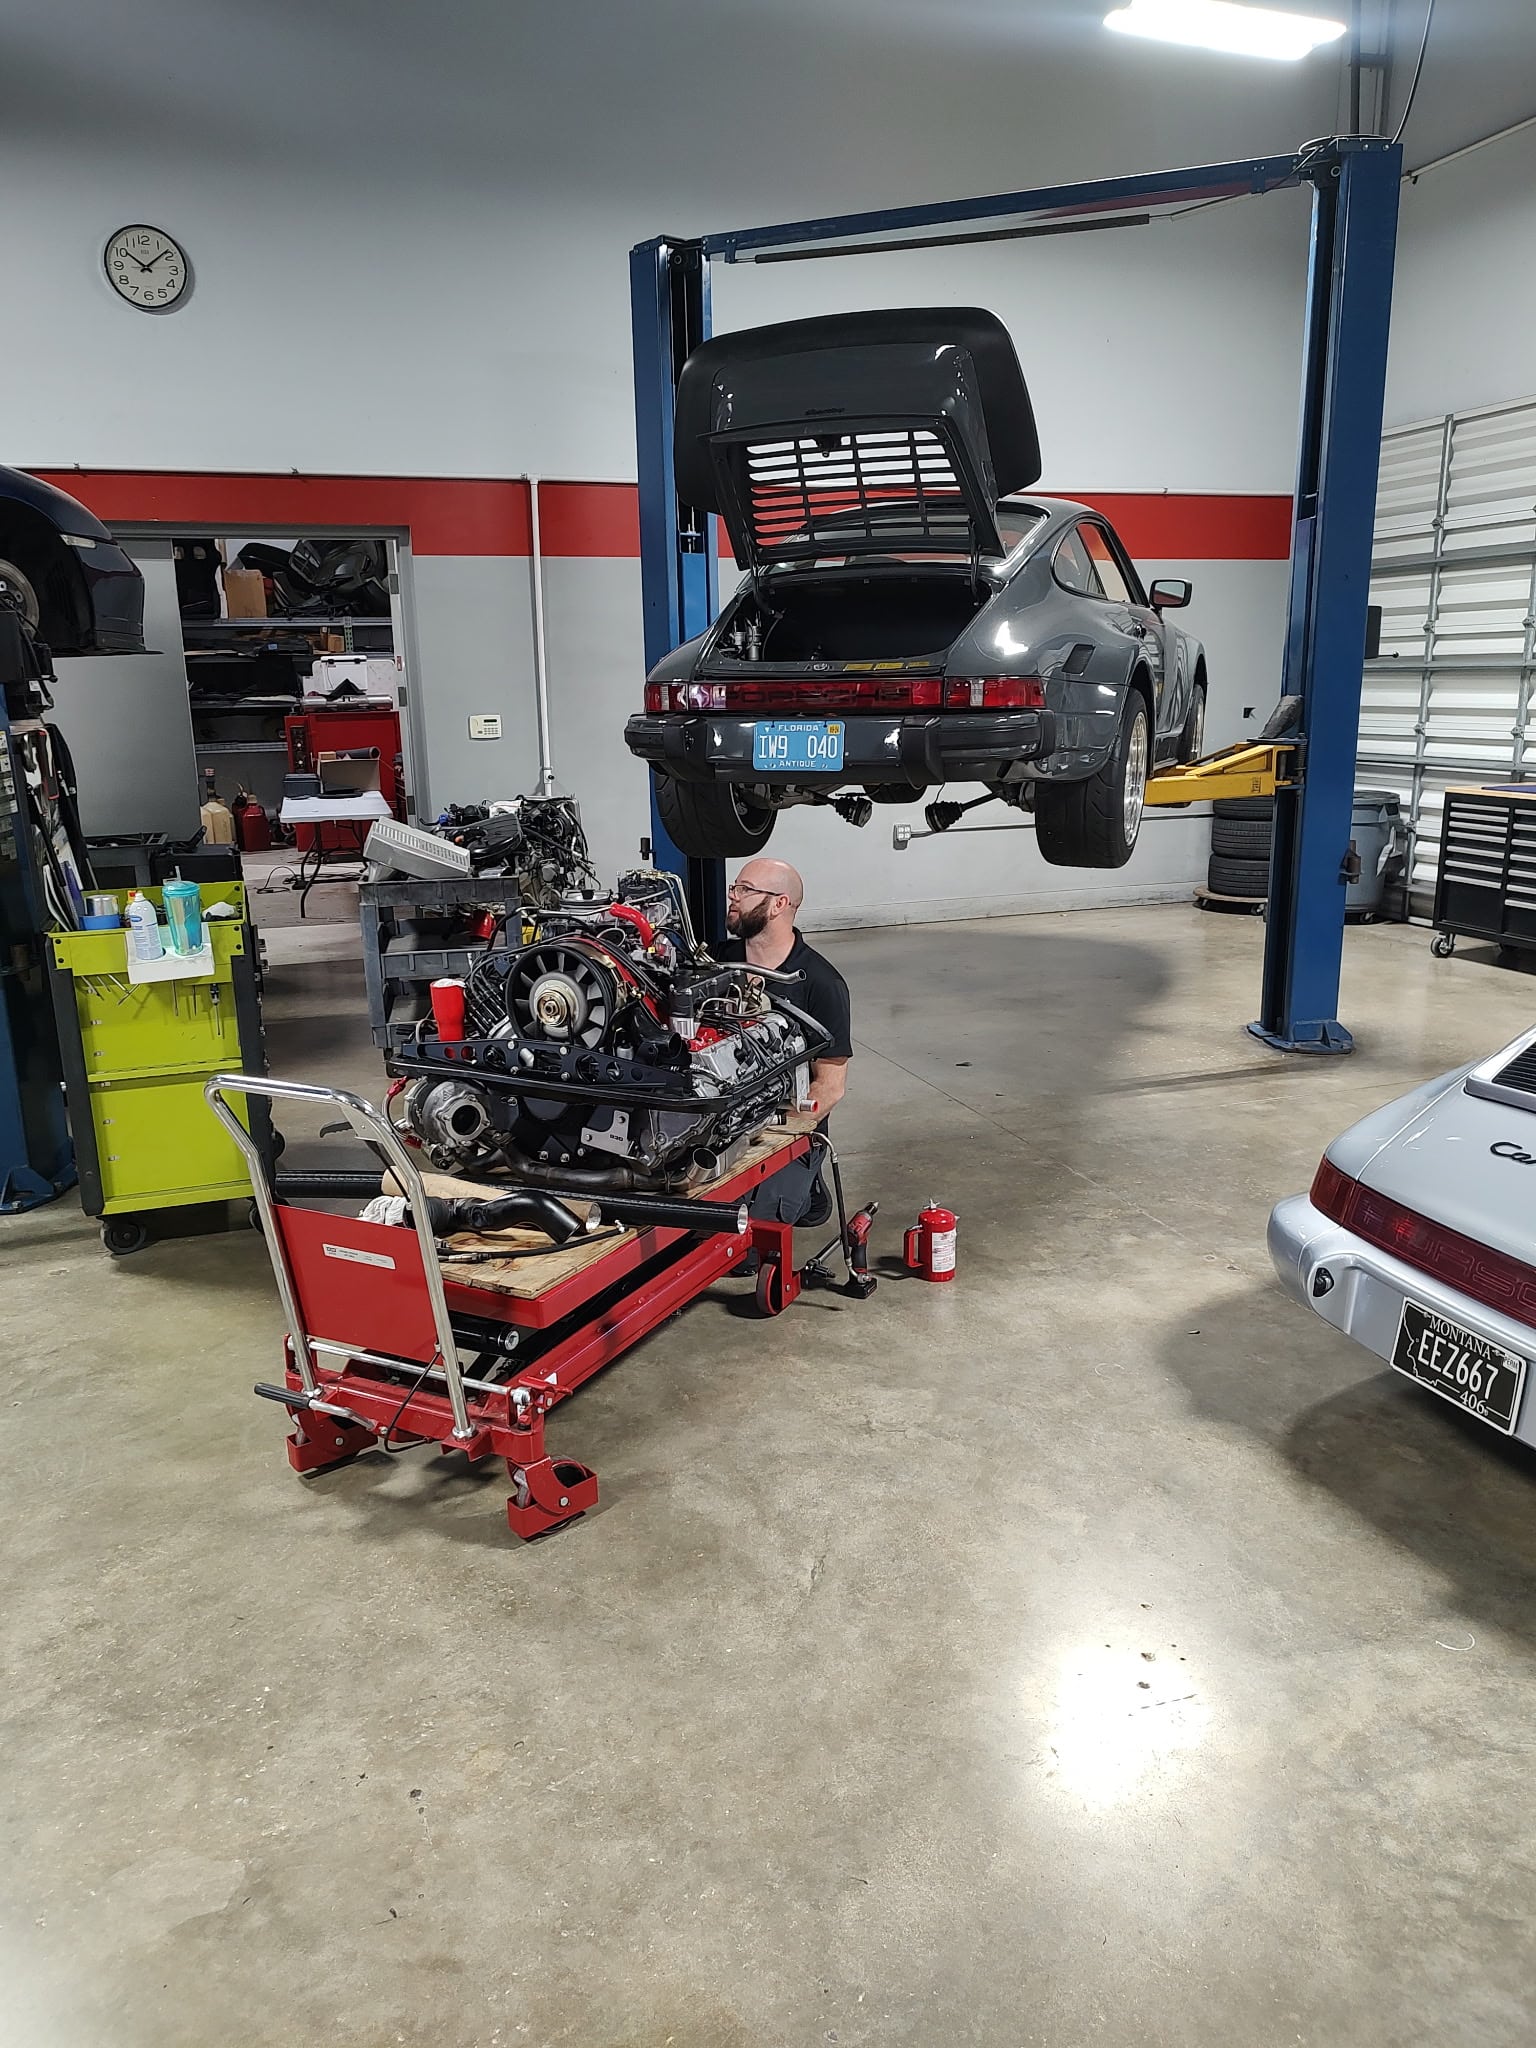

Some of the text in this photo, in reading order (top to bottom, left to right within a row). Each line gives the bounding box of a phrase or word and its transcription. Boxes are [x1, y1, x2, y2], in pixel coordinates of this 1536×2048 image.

[125, 236, 135, 248] 11
[137, 234, 150, 246] 12
[113, 246, 128, 258] 10
[164, 250, 175, 262] 2
[113, 260, 125, 271] 9
[168, 265, 179, 276] 3
[118, 274, 130, 285] 8
[165, 278, 176, 289] 4
[128, 285, 140, 296] 7
[143, 290, 155, 301] 6
[157, 288, 168, 299] 5
[778, 724, 819, 732] FLORIDA
[807, 734, 838, 759] 040
[779, 760, 817, 768] ANTIQUE
[1429, 1315, 1492, 1360] MONTANA
[1417, 1328, 1499, 1400] EEZ667
[1459, 1390, 1487, 1414] 406
